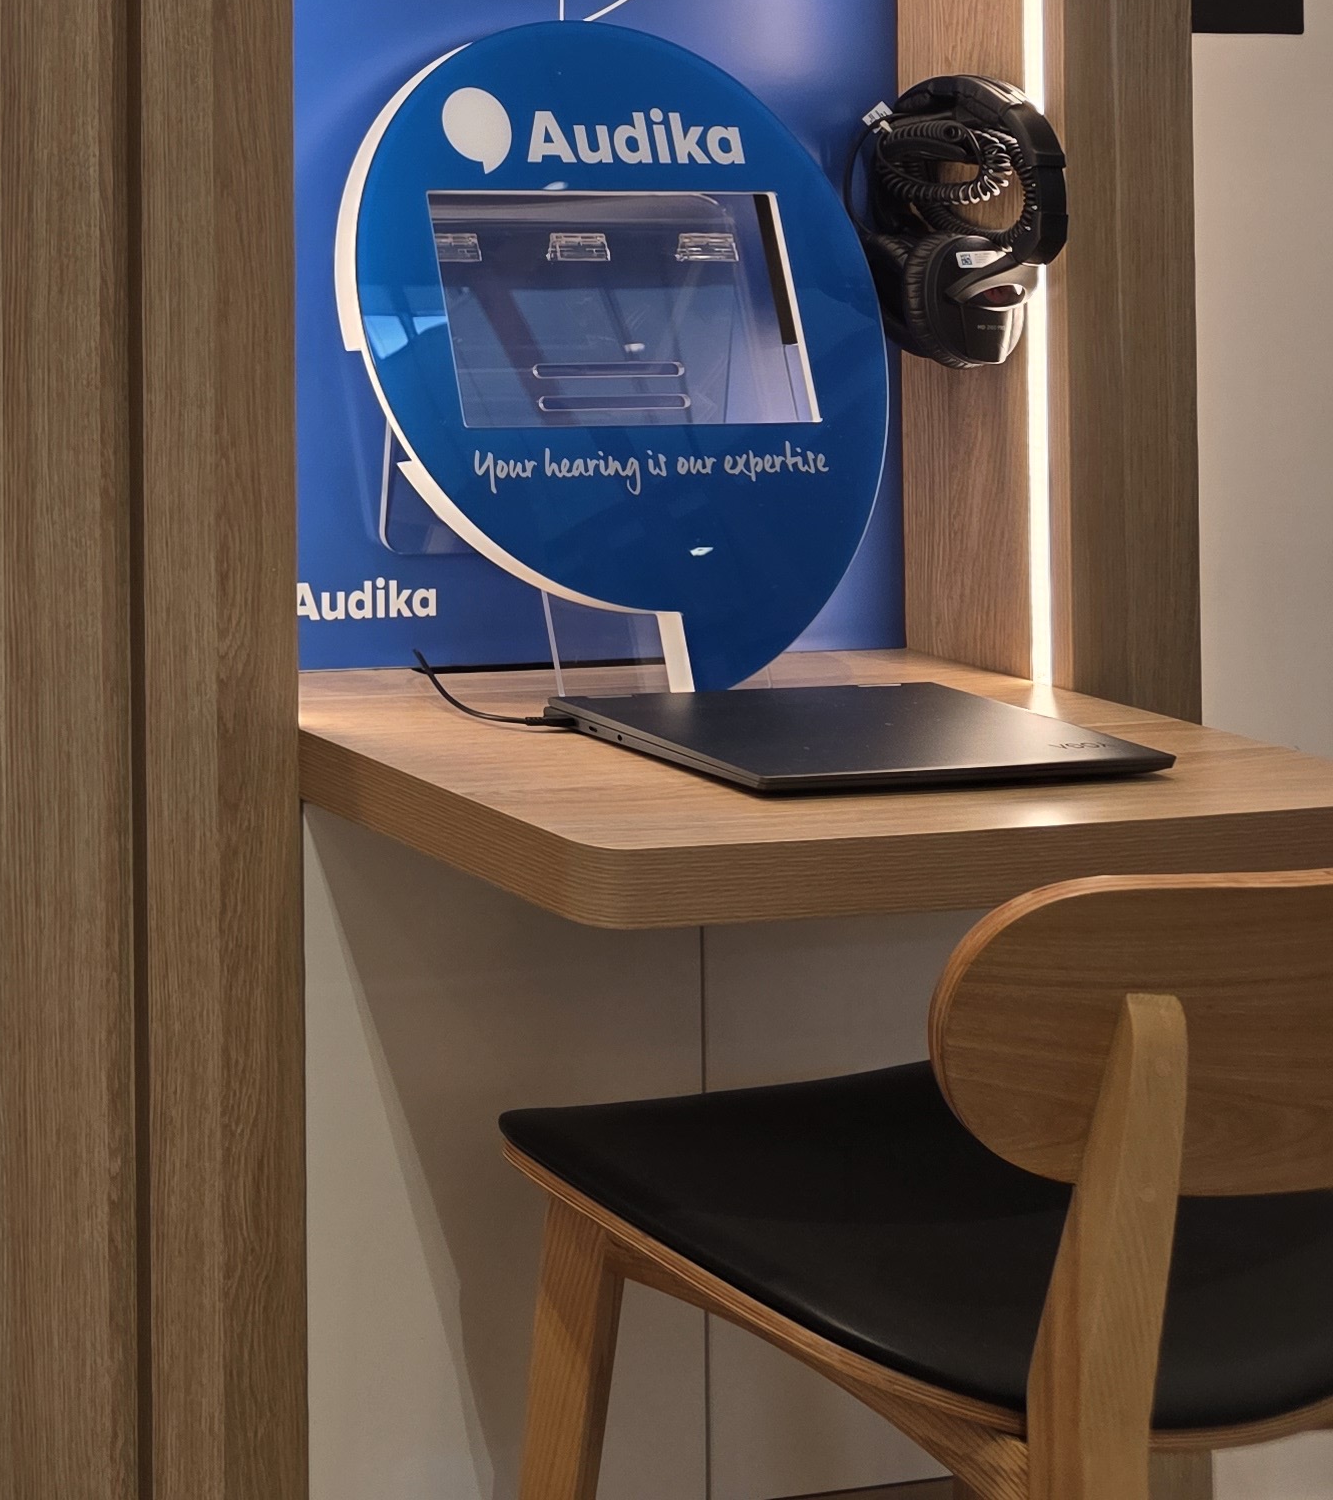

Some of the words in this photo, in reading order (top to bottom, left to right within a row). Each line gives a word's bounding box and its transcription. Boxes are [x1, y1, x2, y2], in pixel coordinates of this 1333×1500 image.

[527, 107, 745, 166] Audika
[474, 449, 537, 494] Your
[545, 447, 642, 496] hearing
[647, 449, 668, 478] is
[677, 455, 717, 475] our
[723, 442, 830, 482] expertise
[296, 576, 437, 621] Audika
